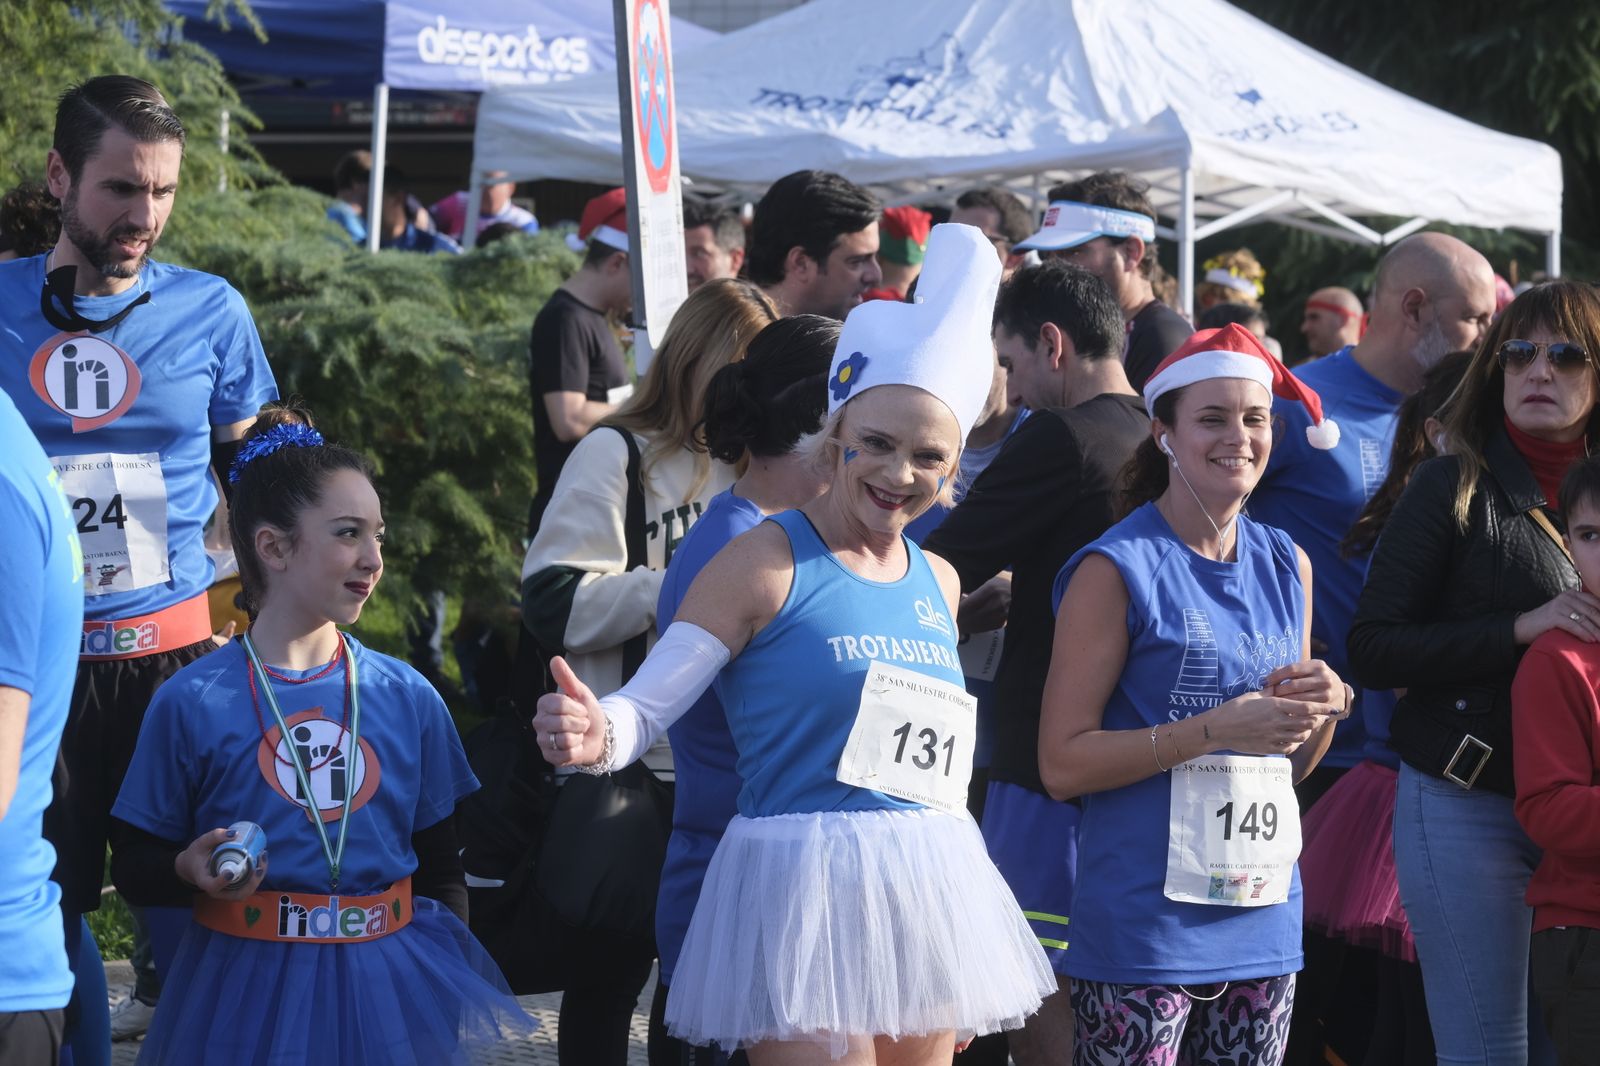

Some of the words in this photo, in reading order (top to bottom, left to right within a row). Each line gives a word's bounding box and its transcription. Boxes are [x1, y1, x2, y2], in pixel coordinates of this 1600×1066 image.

[53, 462, 94, 473] VESTRE
[72, 493, 128, 534] 24
[80, 622, 159, 654] dea
[889, 677, 905, 689] SAN
[906, 680, 947, 701] SILVESTRE
[893, 721, 956, 777] 131
[1198, 763, 1217, 774] SAN
[1216, 801, 1278, 842] 149
[279, 895, 388, 937] indea
